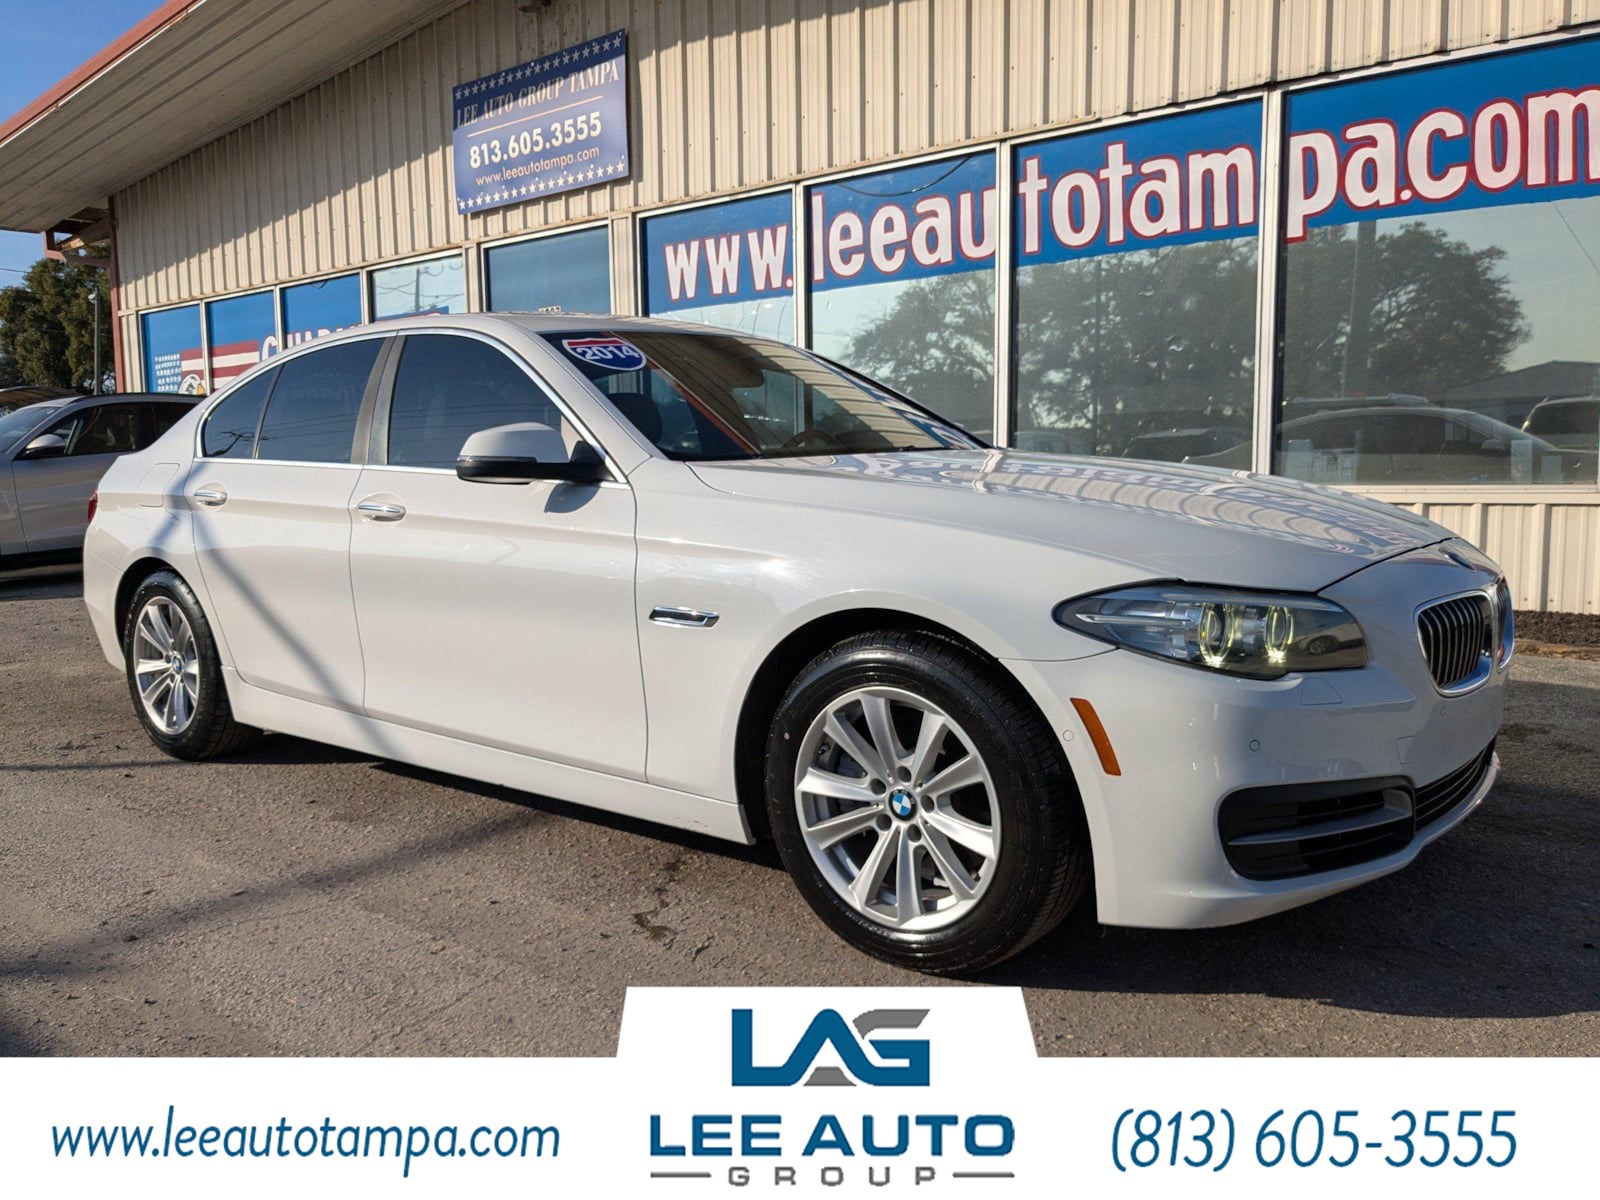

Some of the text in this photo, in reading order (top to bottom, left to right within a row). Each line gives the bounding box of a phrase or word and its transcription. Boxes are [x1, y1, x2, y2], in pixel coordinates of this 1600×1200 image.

[457, 60, 620, 128] LEE AUTO GROUP TAMPA
[469, 111, 603, 169] 813.605.3555
[475, 145, 601, 187] www.leeautotampa.com
[576, 346, 641, 360] 2014
